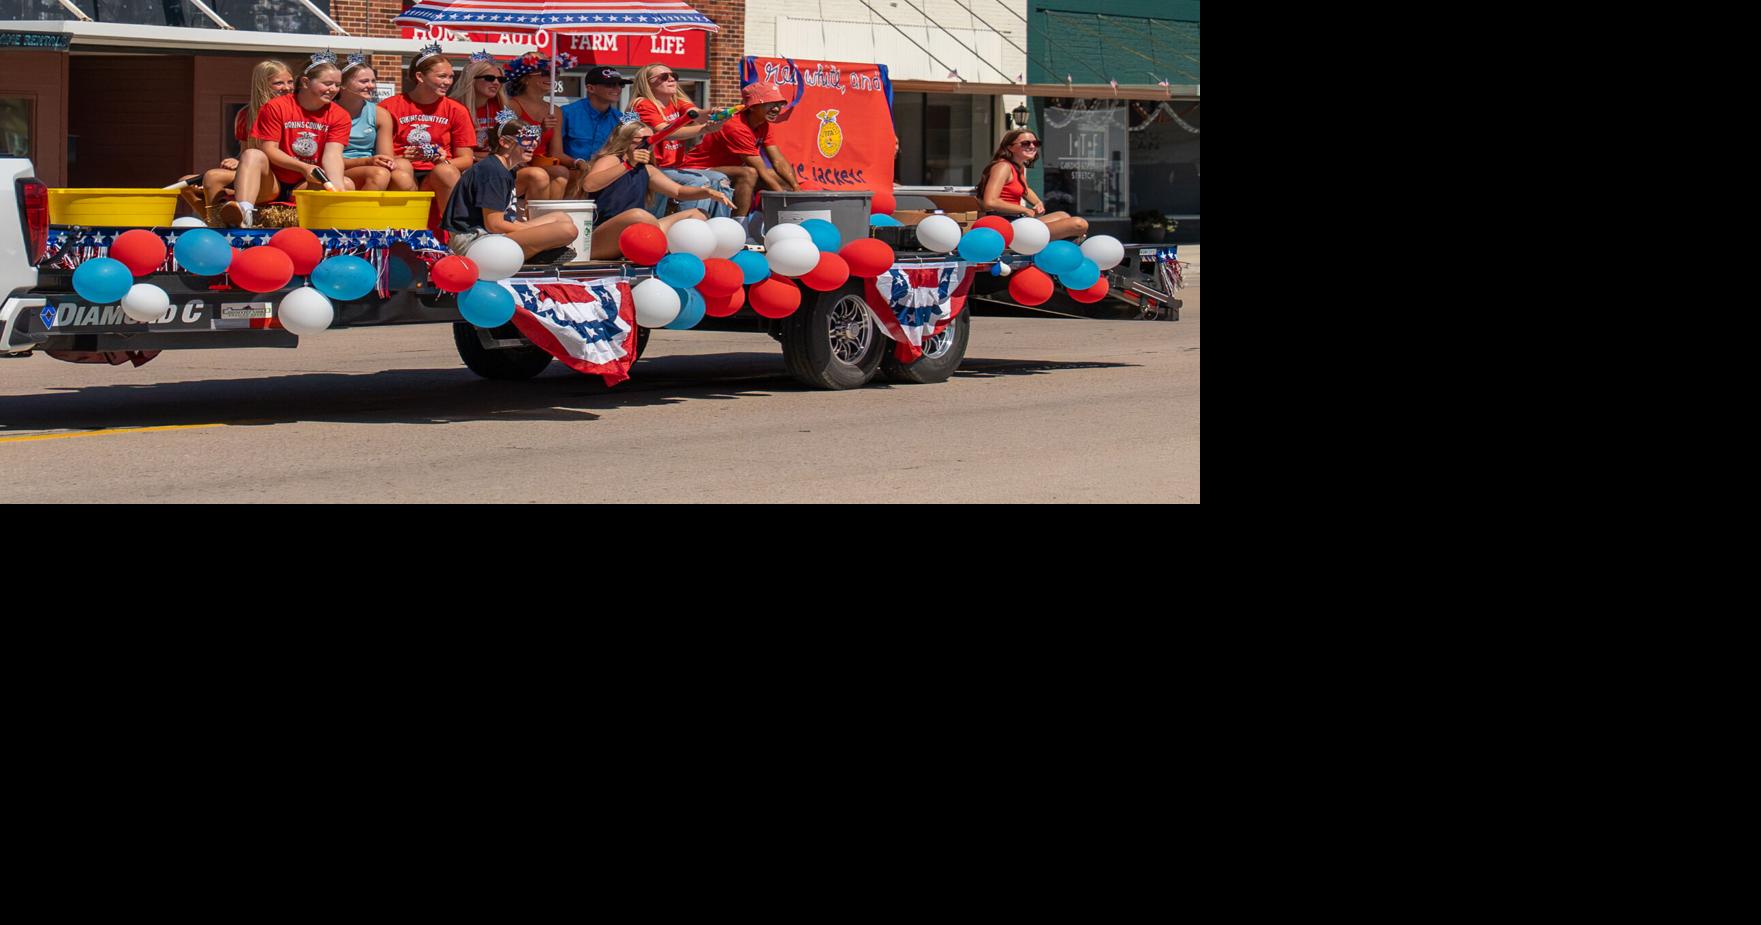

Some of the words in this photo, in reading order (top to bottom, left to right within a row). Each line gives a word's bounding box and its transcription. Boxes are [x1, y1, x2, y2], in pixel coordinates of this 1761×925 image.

[498, 28, 549, 48] AUTO
[570, 33, 618, 51] FARM
[650, 35, 685, 54] LIFE
[850, 71, 881, 91] and
[57, 303, 177, 326] DIAMD
[181, 300, 204, 323] C
